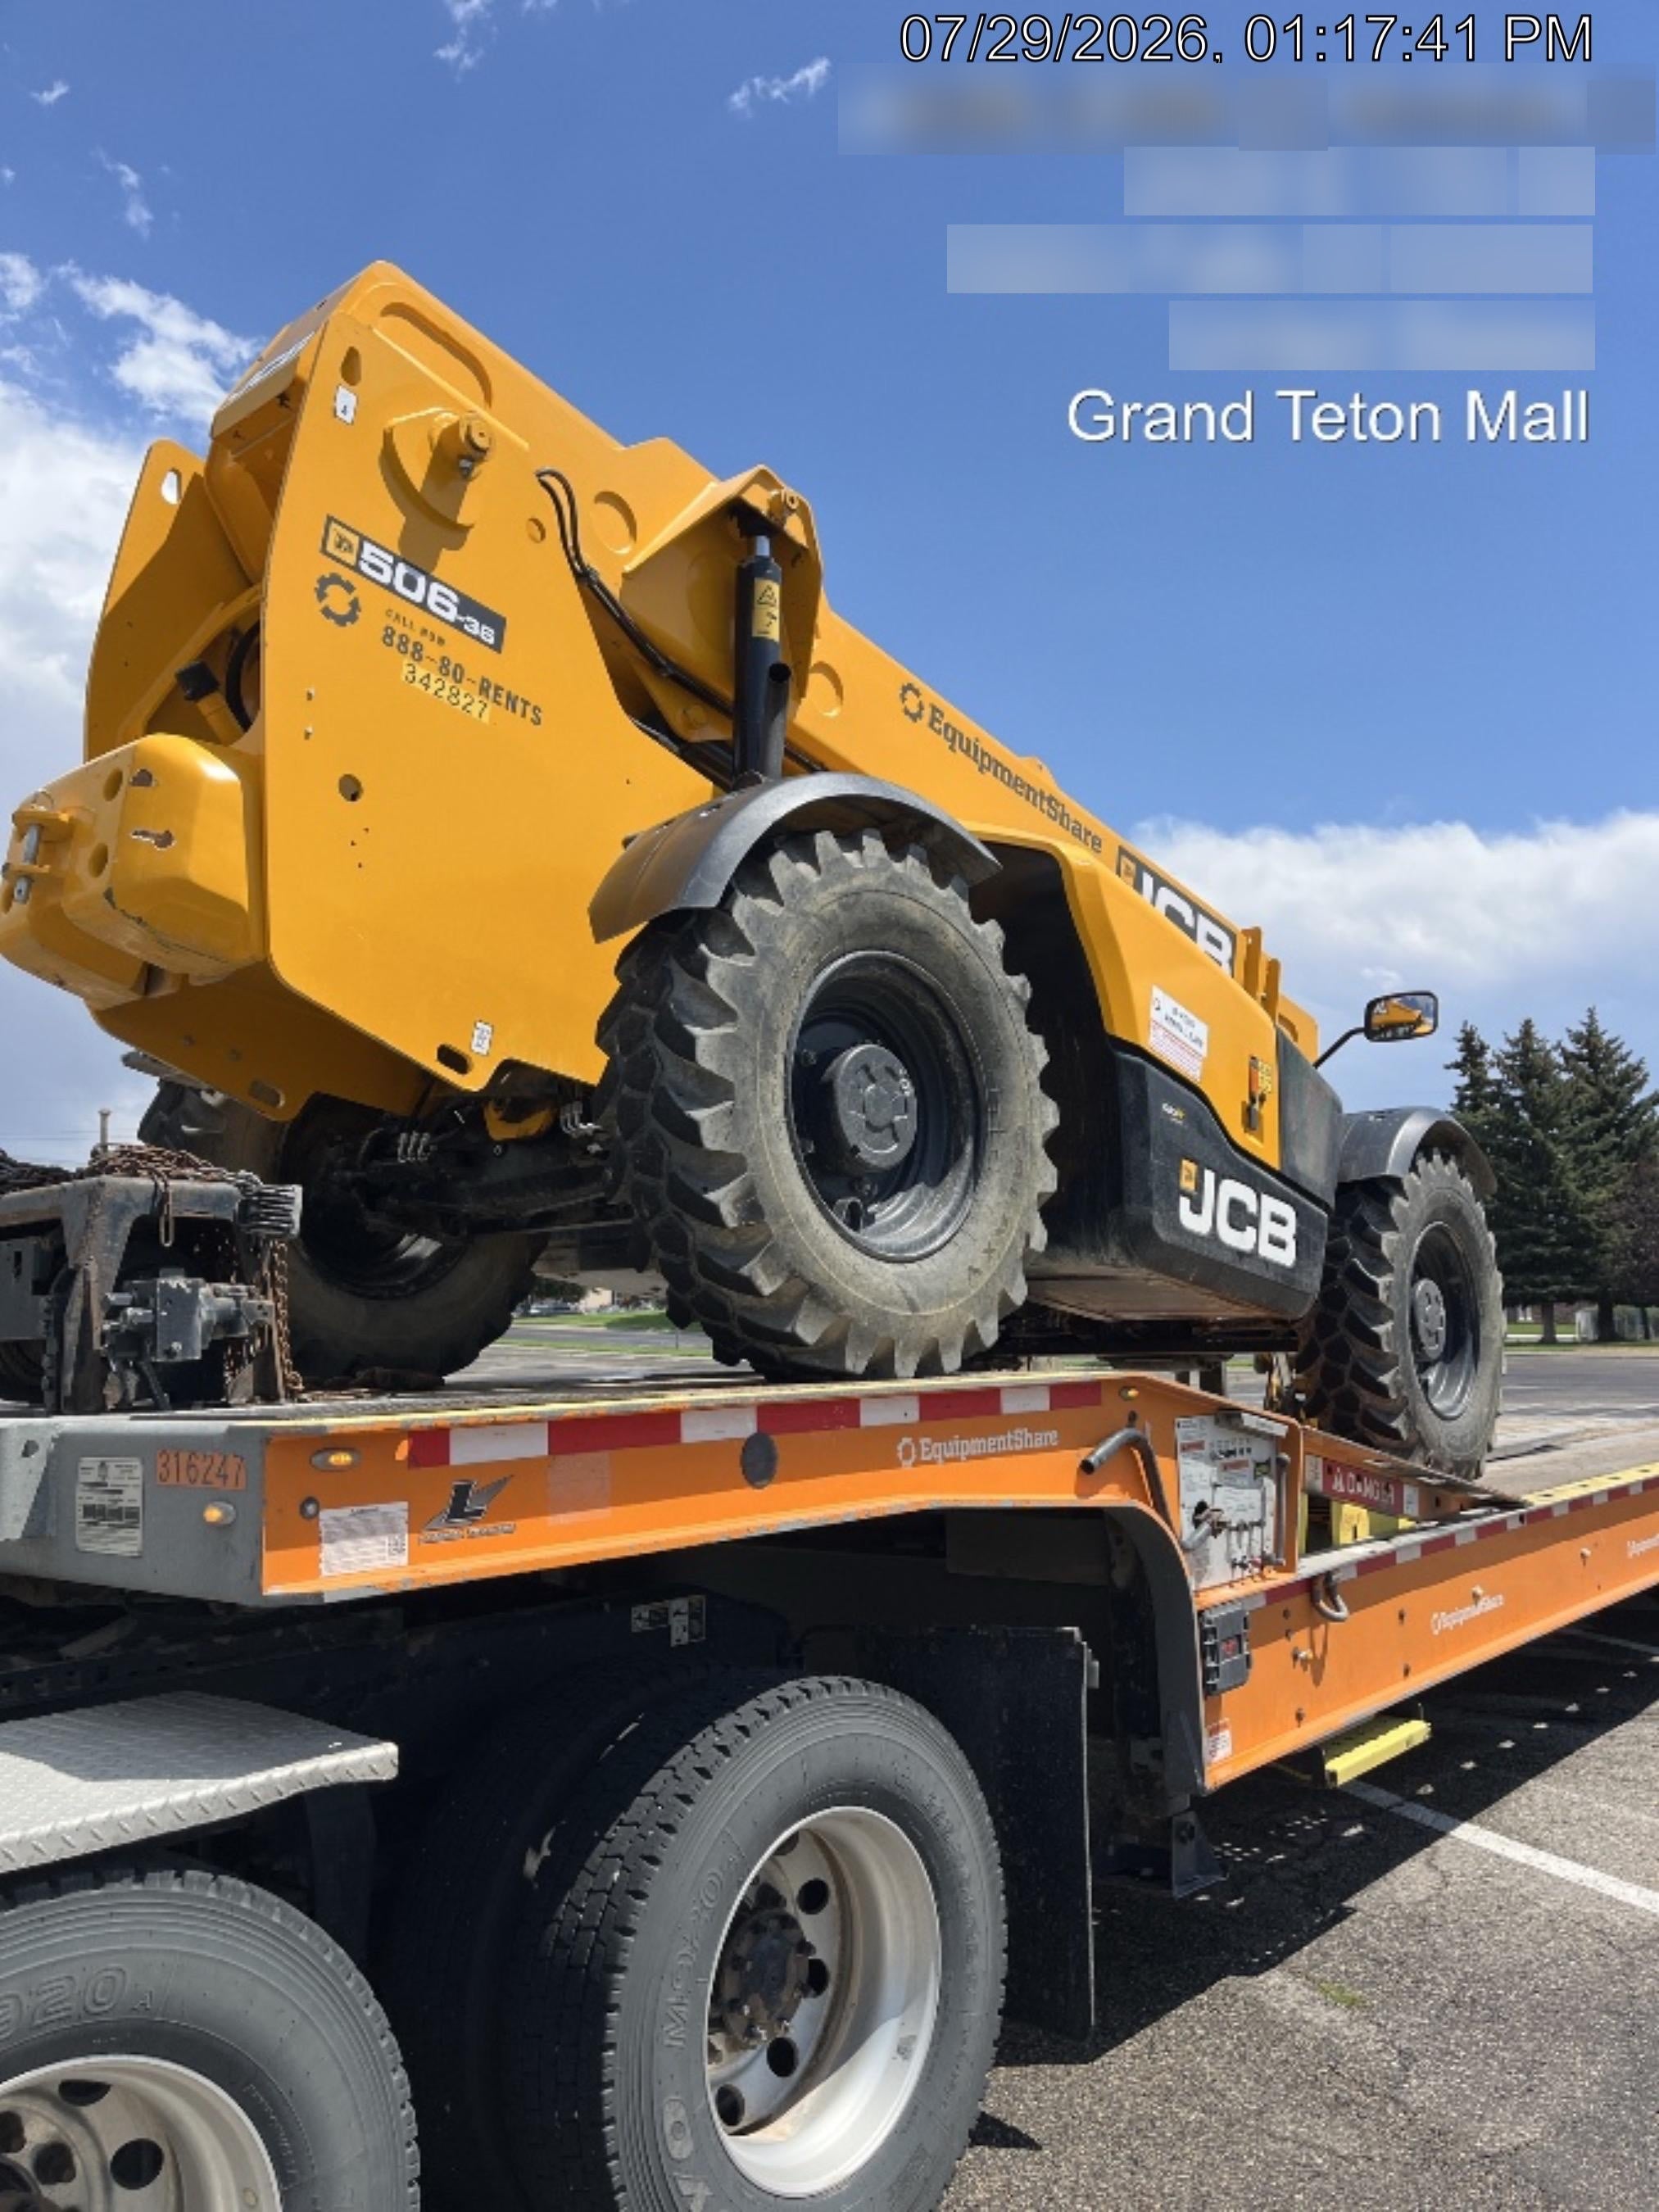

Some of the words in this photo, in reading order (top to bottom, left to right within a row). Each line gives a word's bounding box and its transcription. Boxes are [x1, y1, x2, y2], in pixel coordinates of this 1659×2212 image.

[405, 663, 488, 719] 342827
[928, 702, 1103, 853] EquipmentShare
[1179, 1168, 1297, 1267] JCB
[158, 1450, 245, 1488] 316247
[919, 1428, 1059, 1464] EquipmentShare
